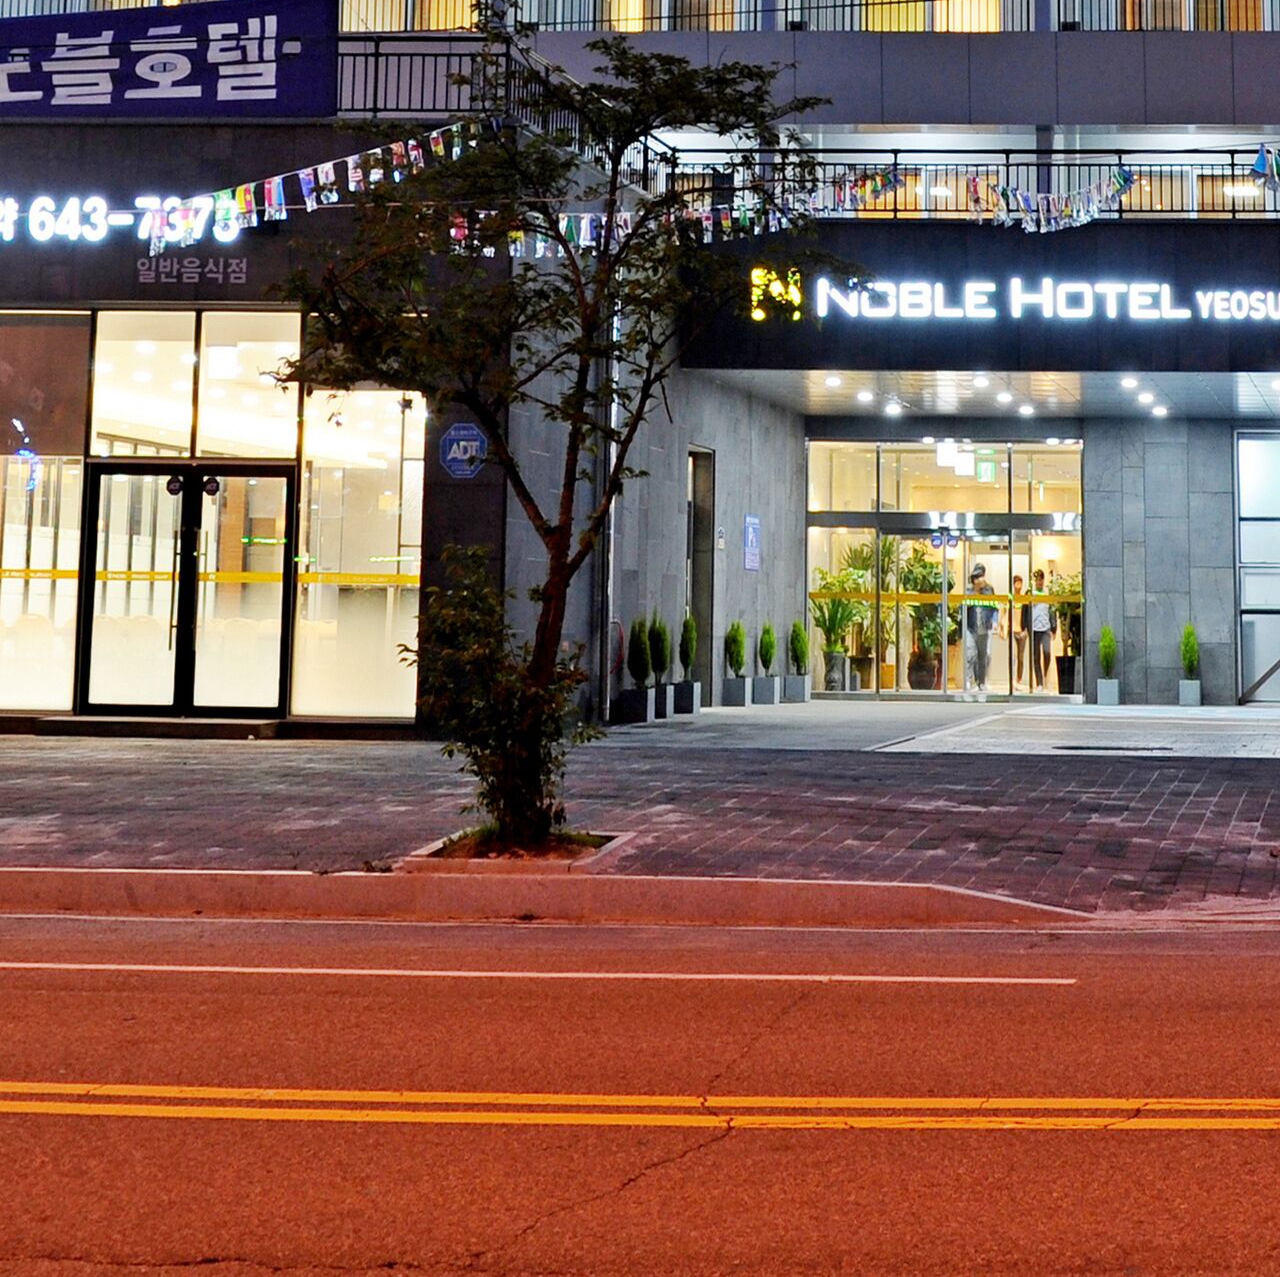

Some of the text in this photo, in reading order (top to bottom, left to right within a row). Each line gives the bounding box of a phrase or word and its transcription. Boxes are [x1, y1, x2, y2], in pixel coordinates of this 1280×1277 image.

[136, 257, 249, 284] 일반음식점
[816, 277, 997, 319] NOBLE
[1010, 277, 1192, 319] HOTEL
[447, 440, 480, 460] ADT
